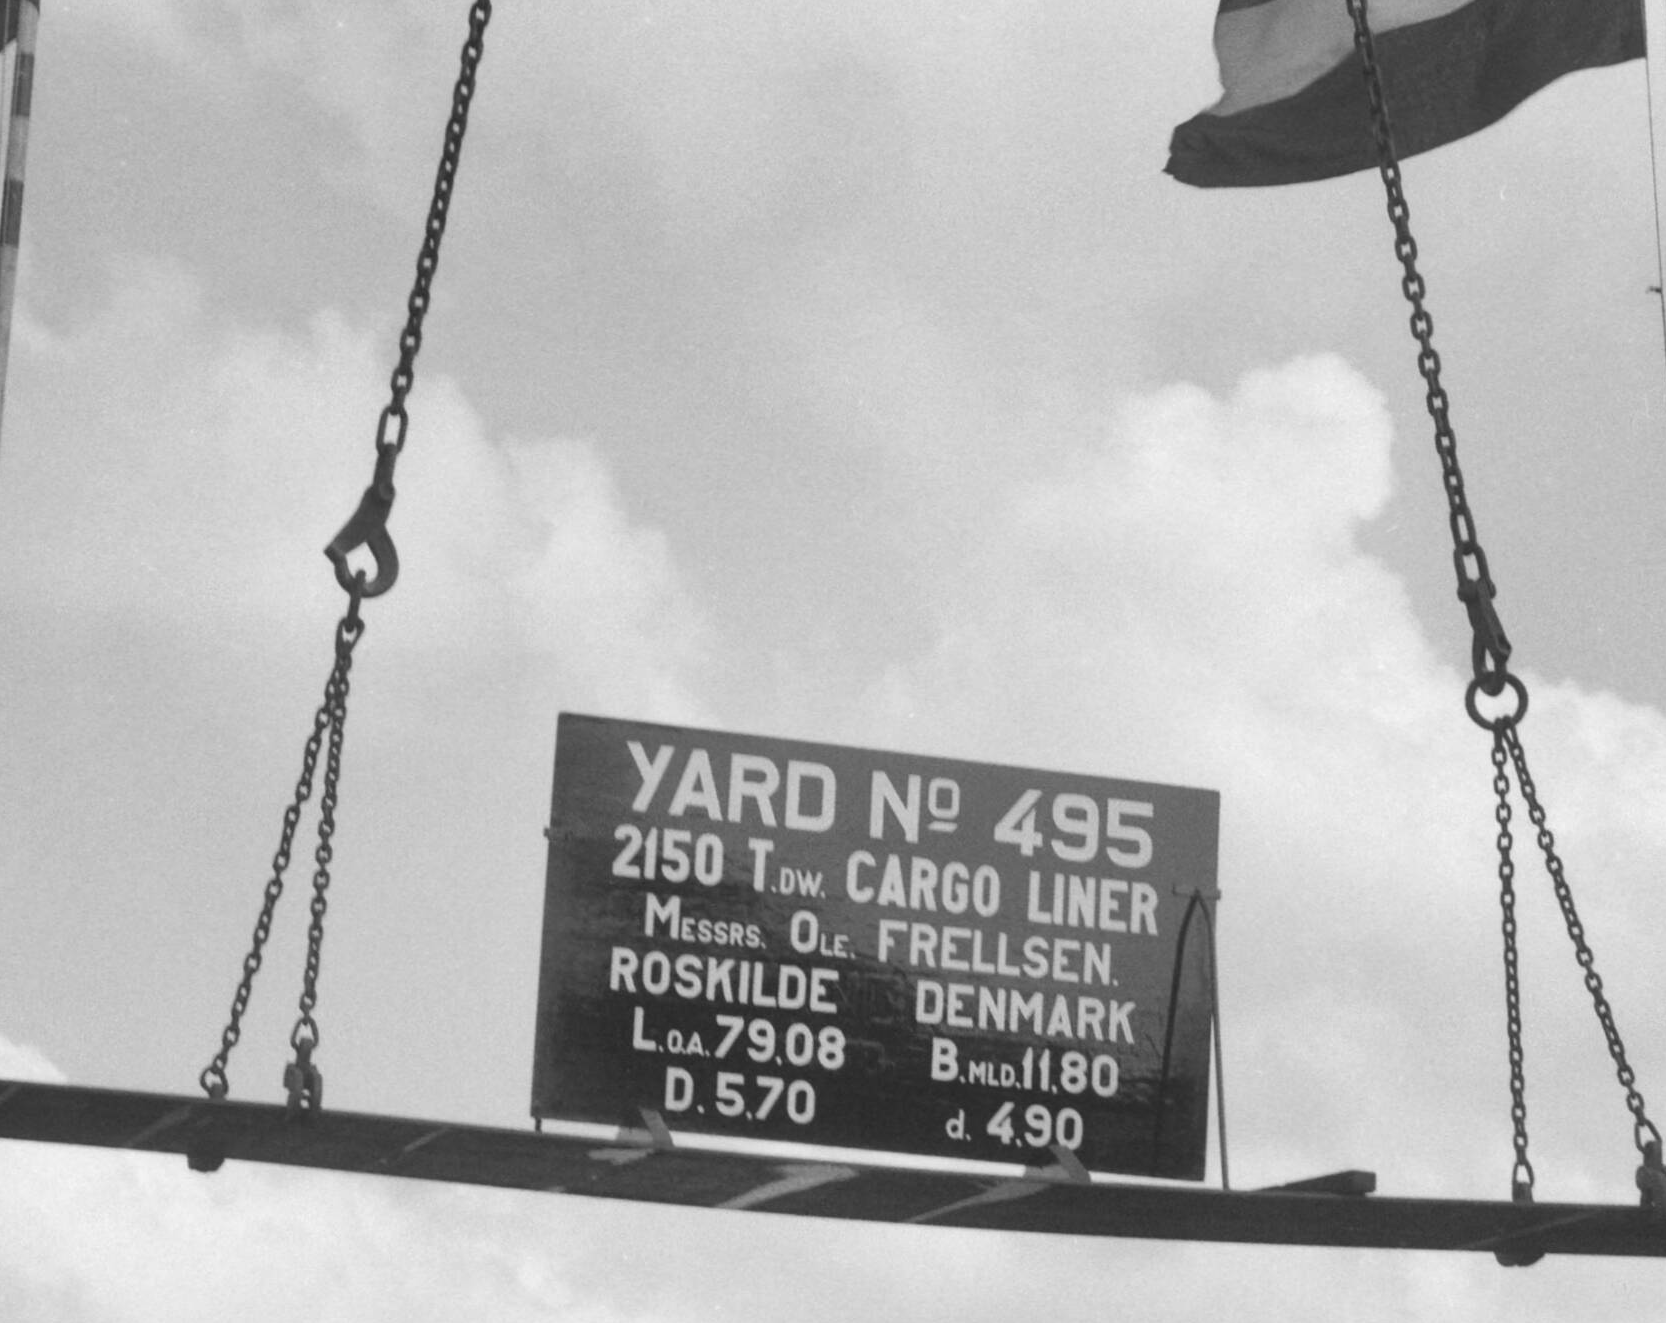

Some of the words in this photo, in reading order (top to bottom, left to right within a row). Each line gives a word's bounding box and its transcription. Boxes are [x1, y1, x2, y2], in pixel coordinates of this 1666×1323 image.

[626, 740, 837, 833] YARD
[993, 791, 1154, 869] 495
[611, 823, 724, 886] 2150
[845, 850, 1001, 917] CARGO
[1027, 870, 1159, 936] LINER
[609, 946, 840, 1014] ROSKILDE
[915, 979, 1136, 1045] DENMARK
[877, 919, 1121, 987] FRELLSEN.
